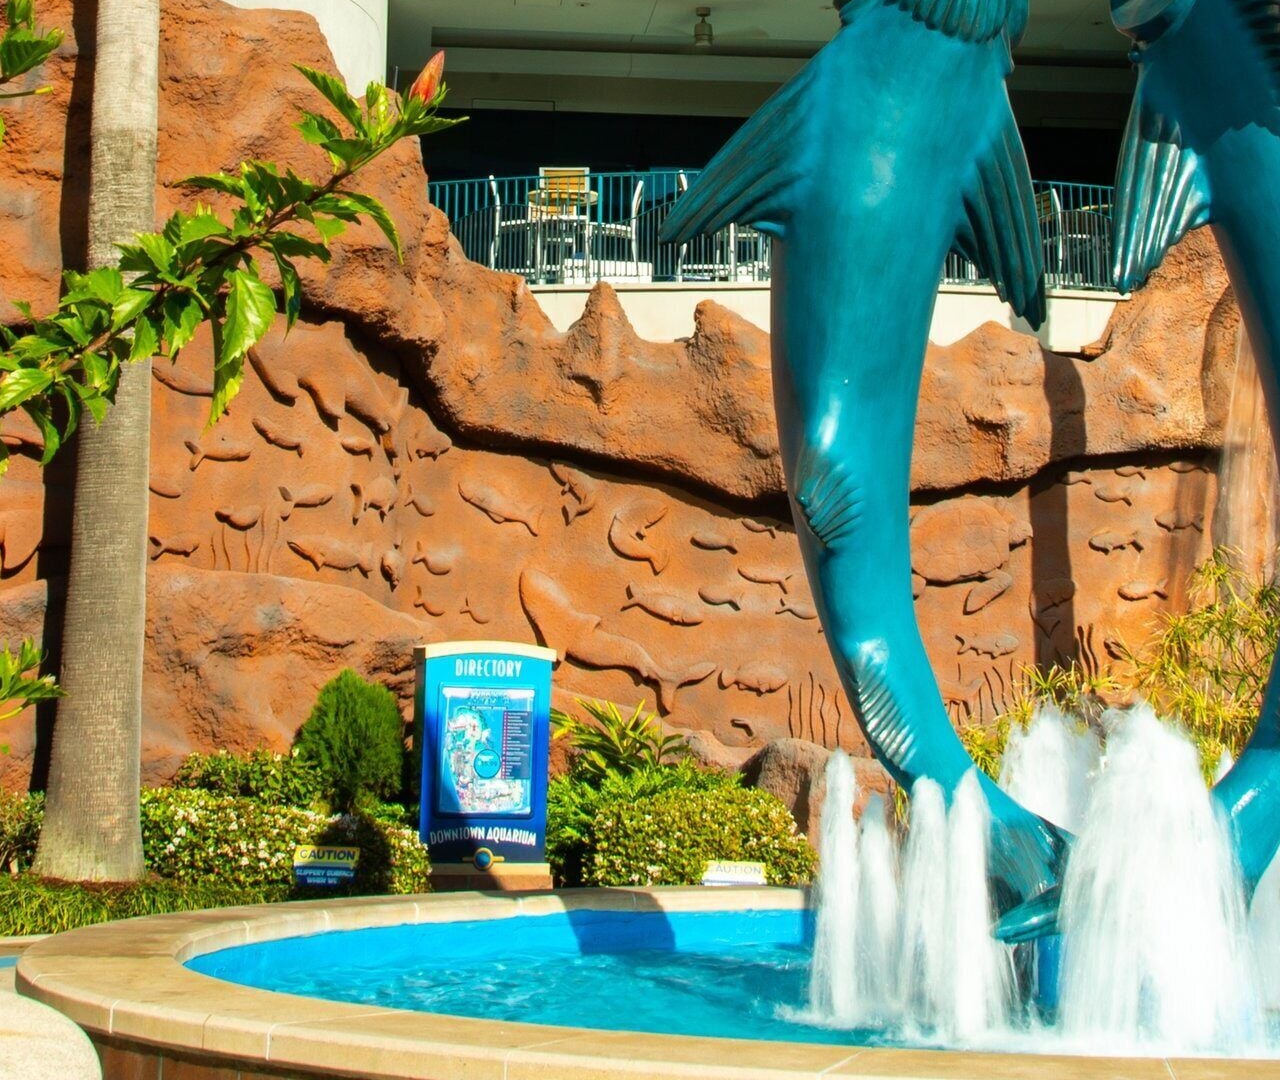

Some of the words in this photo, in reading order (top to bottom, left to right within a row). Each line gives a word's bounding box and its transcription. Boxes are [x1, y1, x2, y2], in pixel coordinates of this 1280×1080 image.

[455, 658, 523, 677] DIRECTORY
[430, 827, 485, 844] DOWNTOWN
[486, 826, 537, 846] AQUARIUM
[300, 849, 357, 860] CAUTION
[708, 865, 762, 874] AUTION
